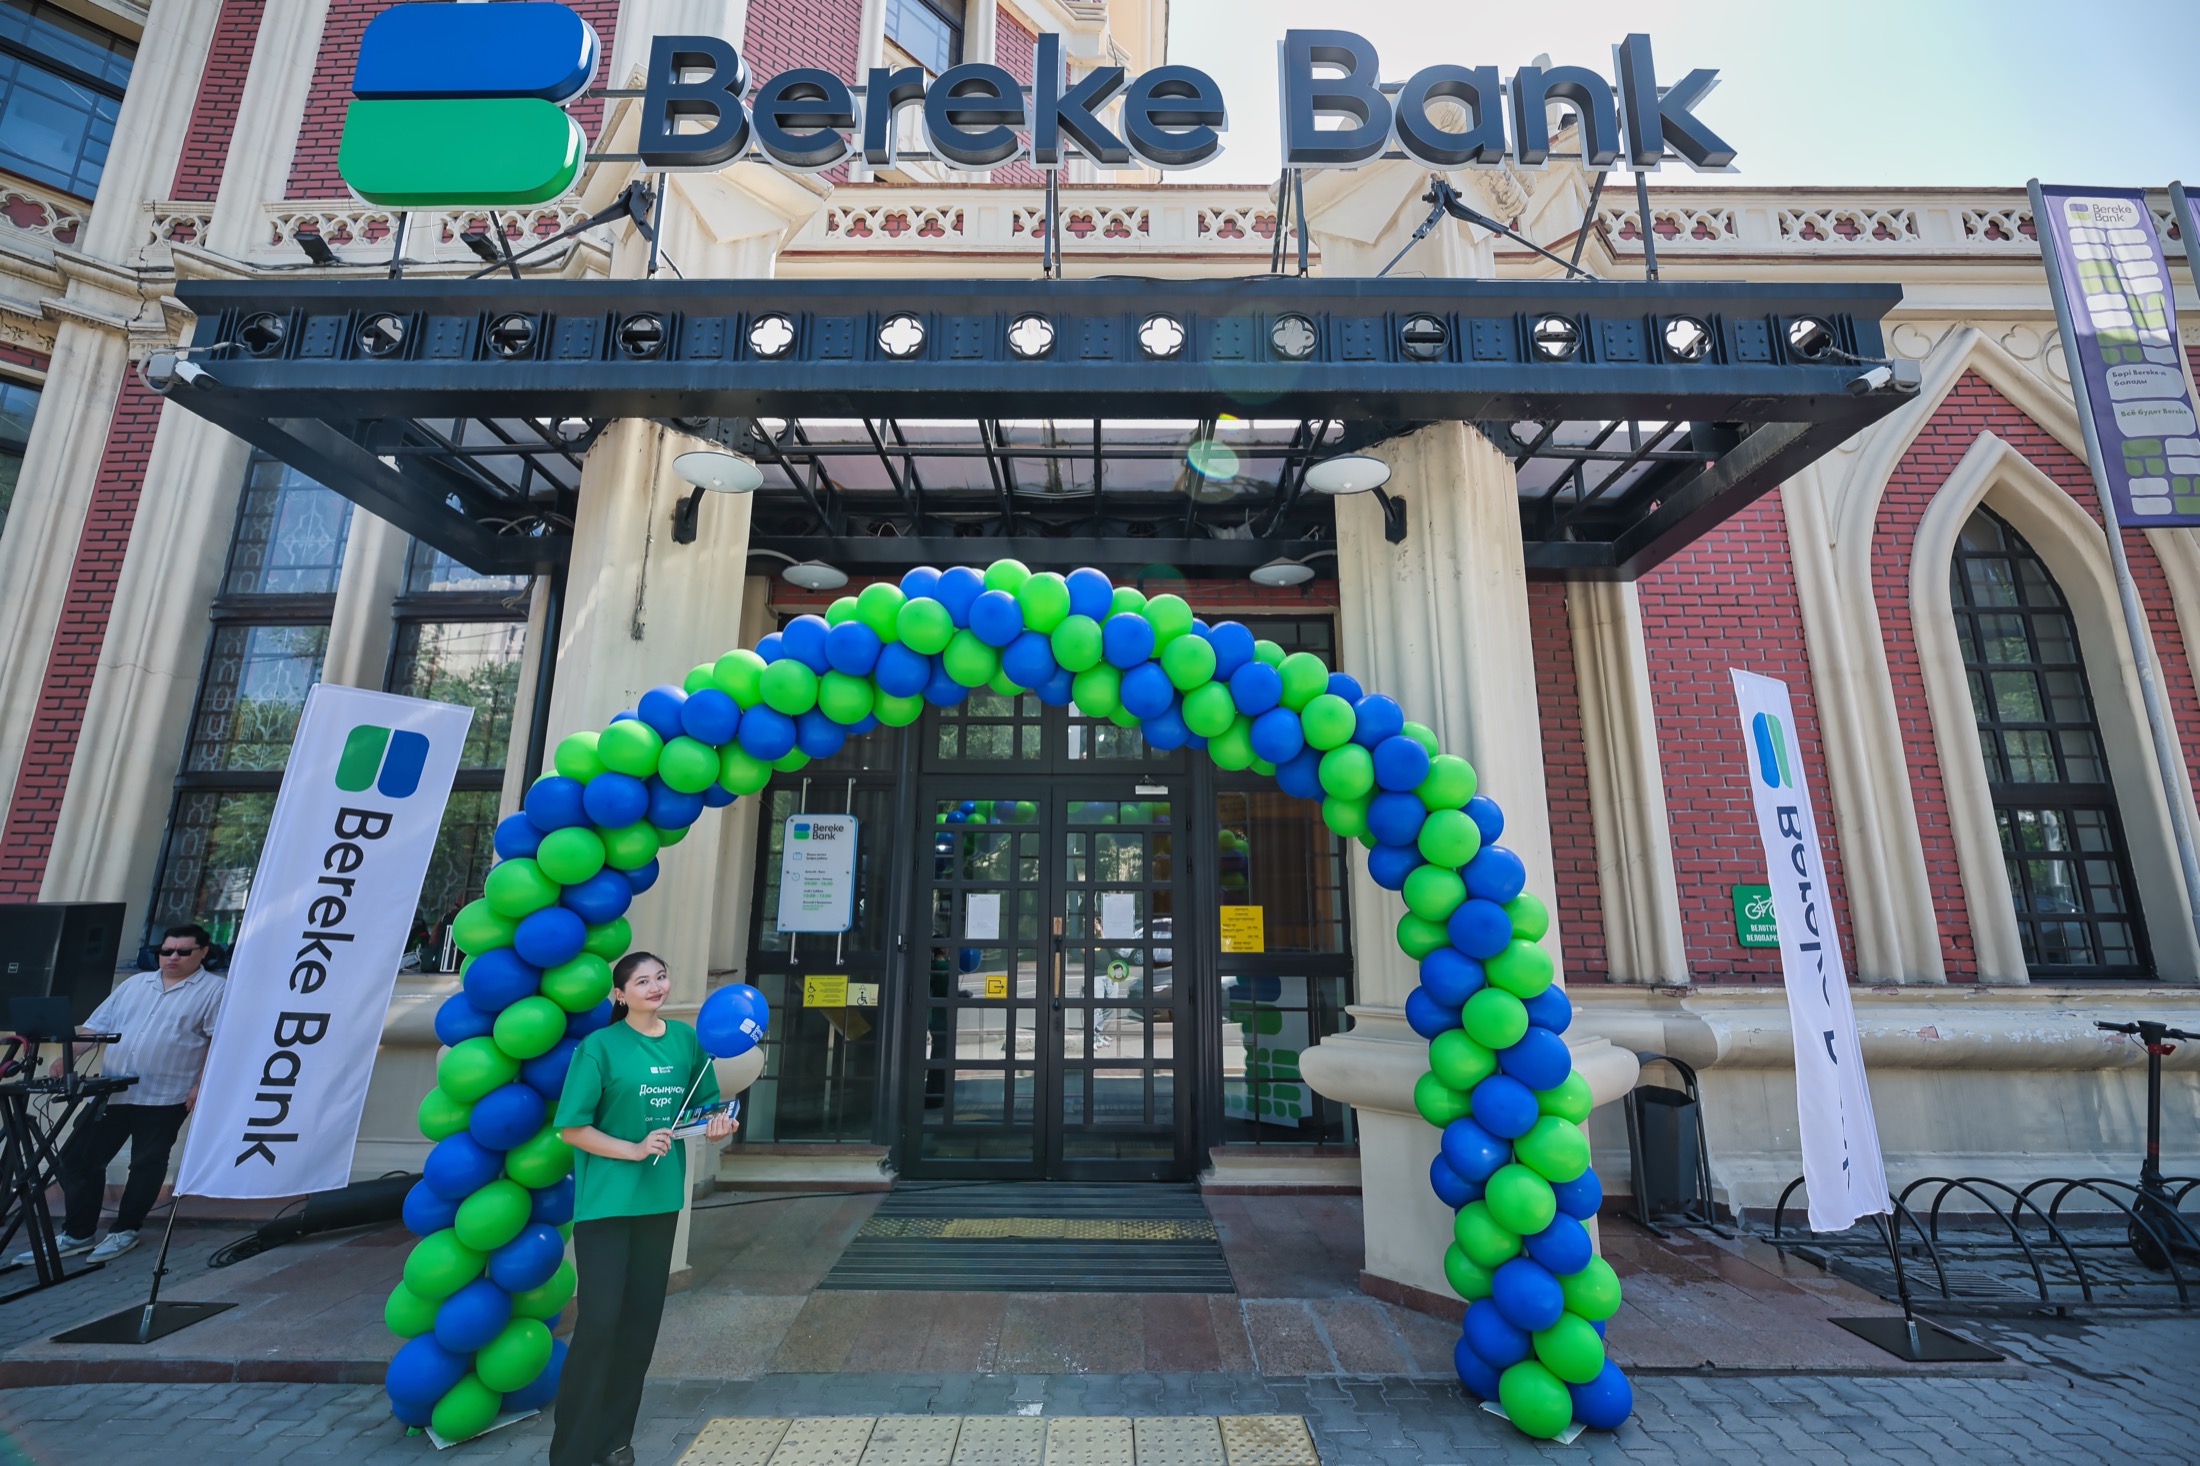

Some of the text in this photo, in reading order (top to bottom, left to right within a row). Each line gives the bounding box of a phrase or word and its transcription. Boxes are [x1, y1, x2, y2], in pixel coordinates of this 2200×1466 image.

[638, 28, 1740, 173] Bereke Bank
[2092, 204, 2132, 214] Bereke
[2094, 212, 2125, 222] Bank
[2114, 379, 2148, 387] болады
[2137, 408, 2161, 417] будет
[812, 823, 845, 832] Bereke
[812, 831, 836, 841] Bank
[234, 807, 393, 1169] Bereke Bank
